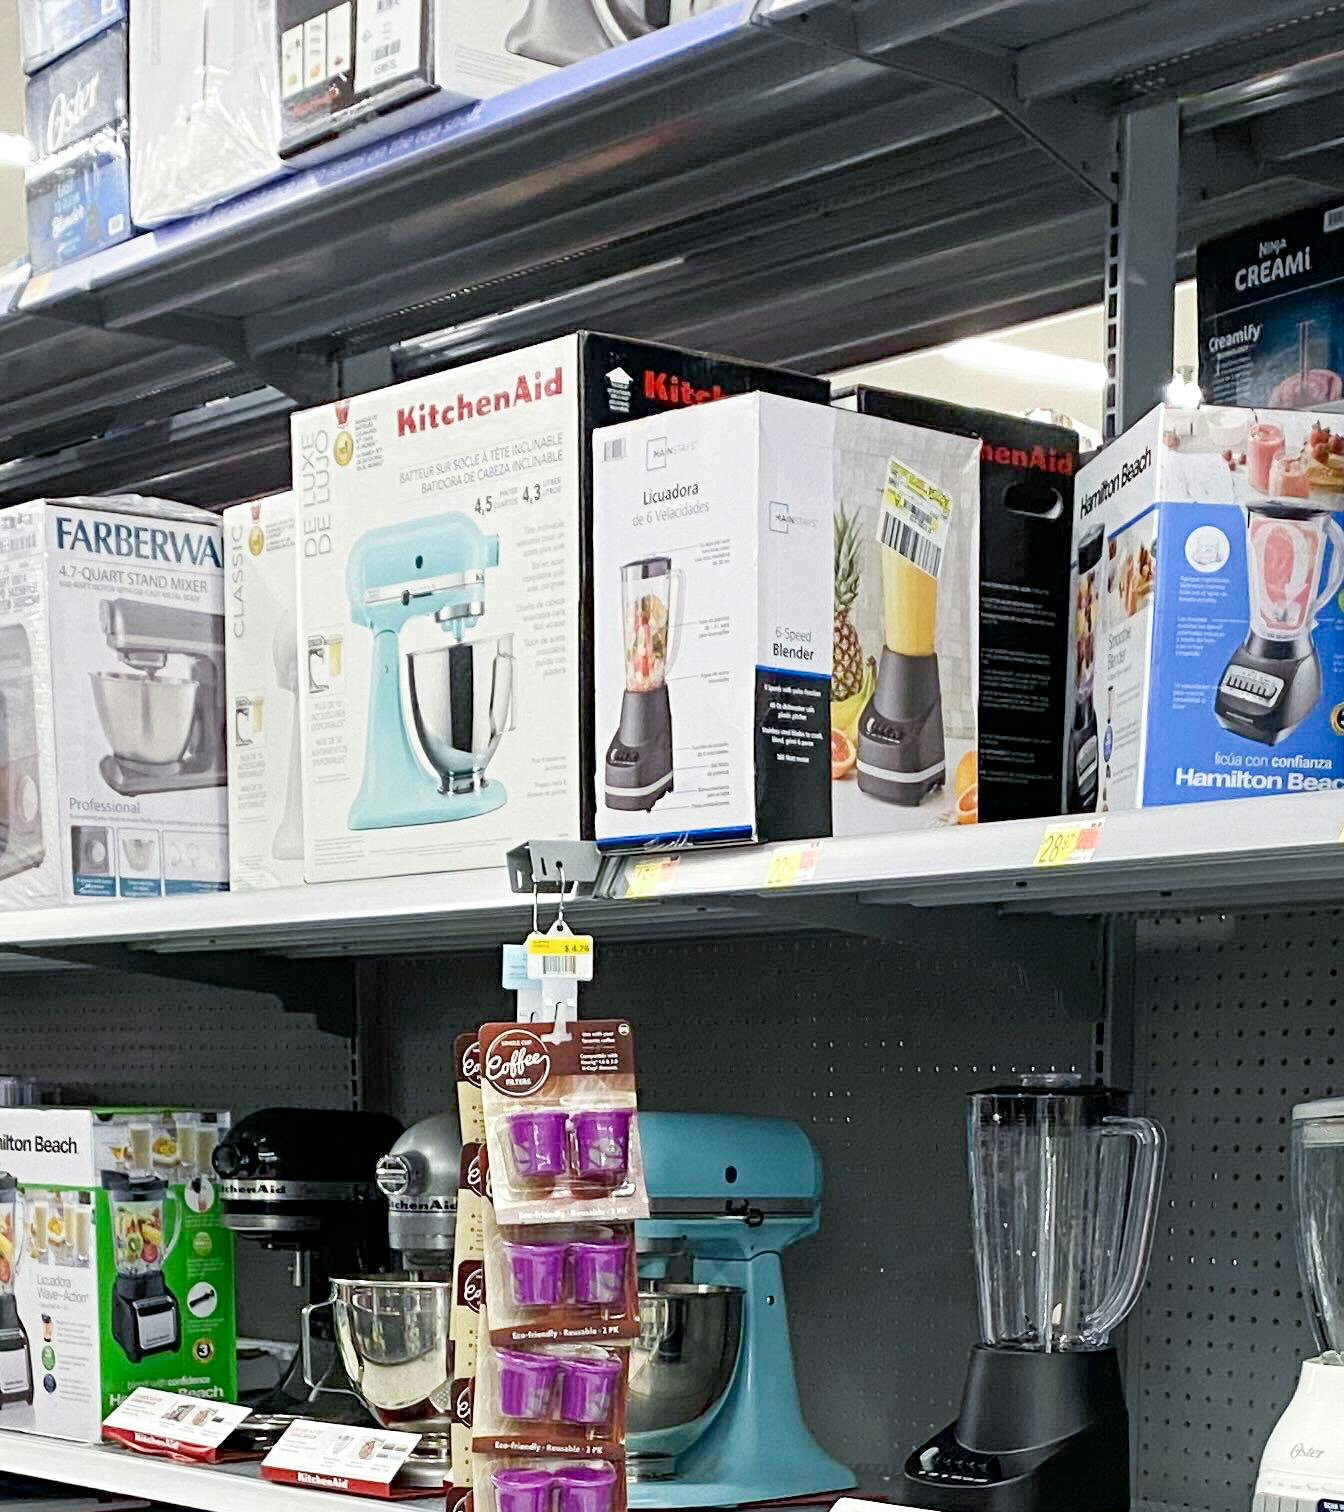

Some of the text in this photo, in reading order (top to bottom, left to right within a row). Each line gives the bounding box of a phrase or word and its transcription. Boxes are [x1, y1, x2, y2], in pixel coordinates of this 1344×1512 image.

[1208, 323, 1263, 353] Creamify
[396, 366, 564, 437] KitchenAid
[421, 449, 563, 495] BATIDORA INCLINABLE
[1079, 446, 1152, 520] Hamilton Beach
[643, 481, 699, 506] Licuadora
[58, 567, 208, 593] 4.7-QUART STAND MIXER
[233, 526, 246, 638] CLASSIC
[775, 626, 812, 643] 6-Speed
[772, 643, 815, 662] Blender
[1246, 754, 1332, 770] con confianza
[1175, 768, 1284, 789] Hamilton
[69, 797, 141, 815] Professional
[486, 1046, 550, 1080] Coffee
[35, 1136, 78, 1154] Beach
[37, 1273, 72, 1288] Licuadora
[512, 1325, 597, 1341] Eco-friendly Reusable
[494, 1440, 581, 1454] Eco-friendly Reusable
[1290, 1440, 1325, 1460] Oster
[297, 1471, 349, 1490] KitchenAid
